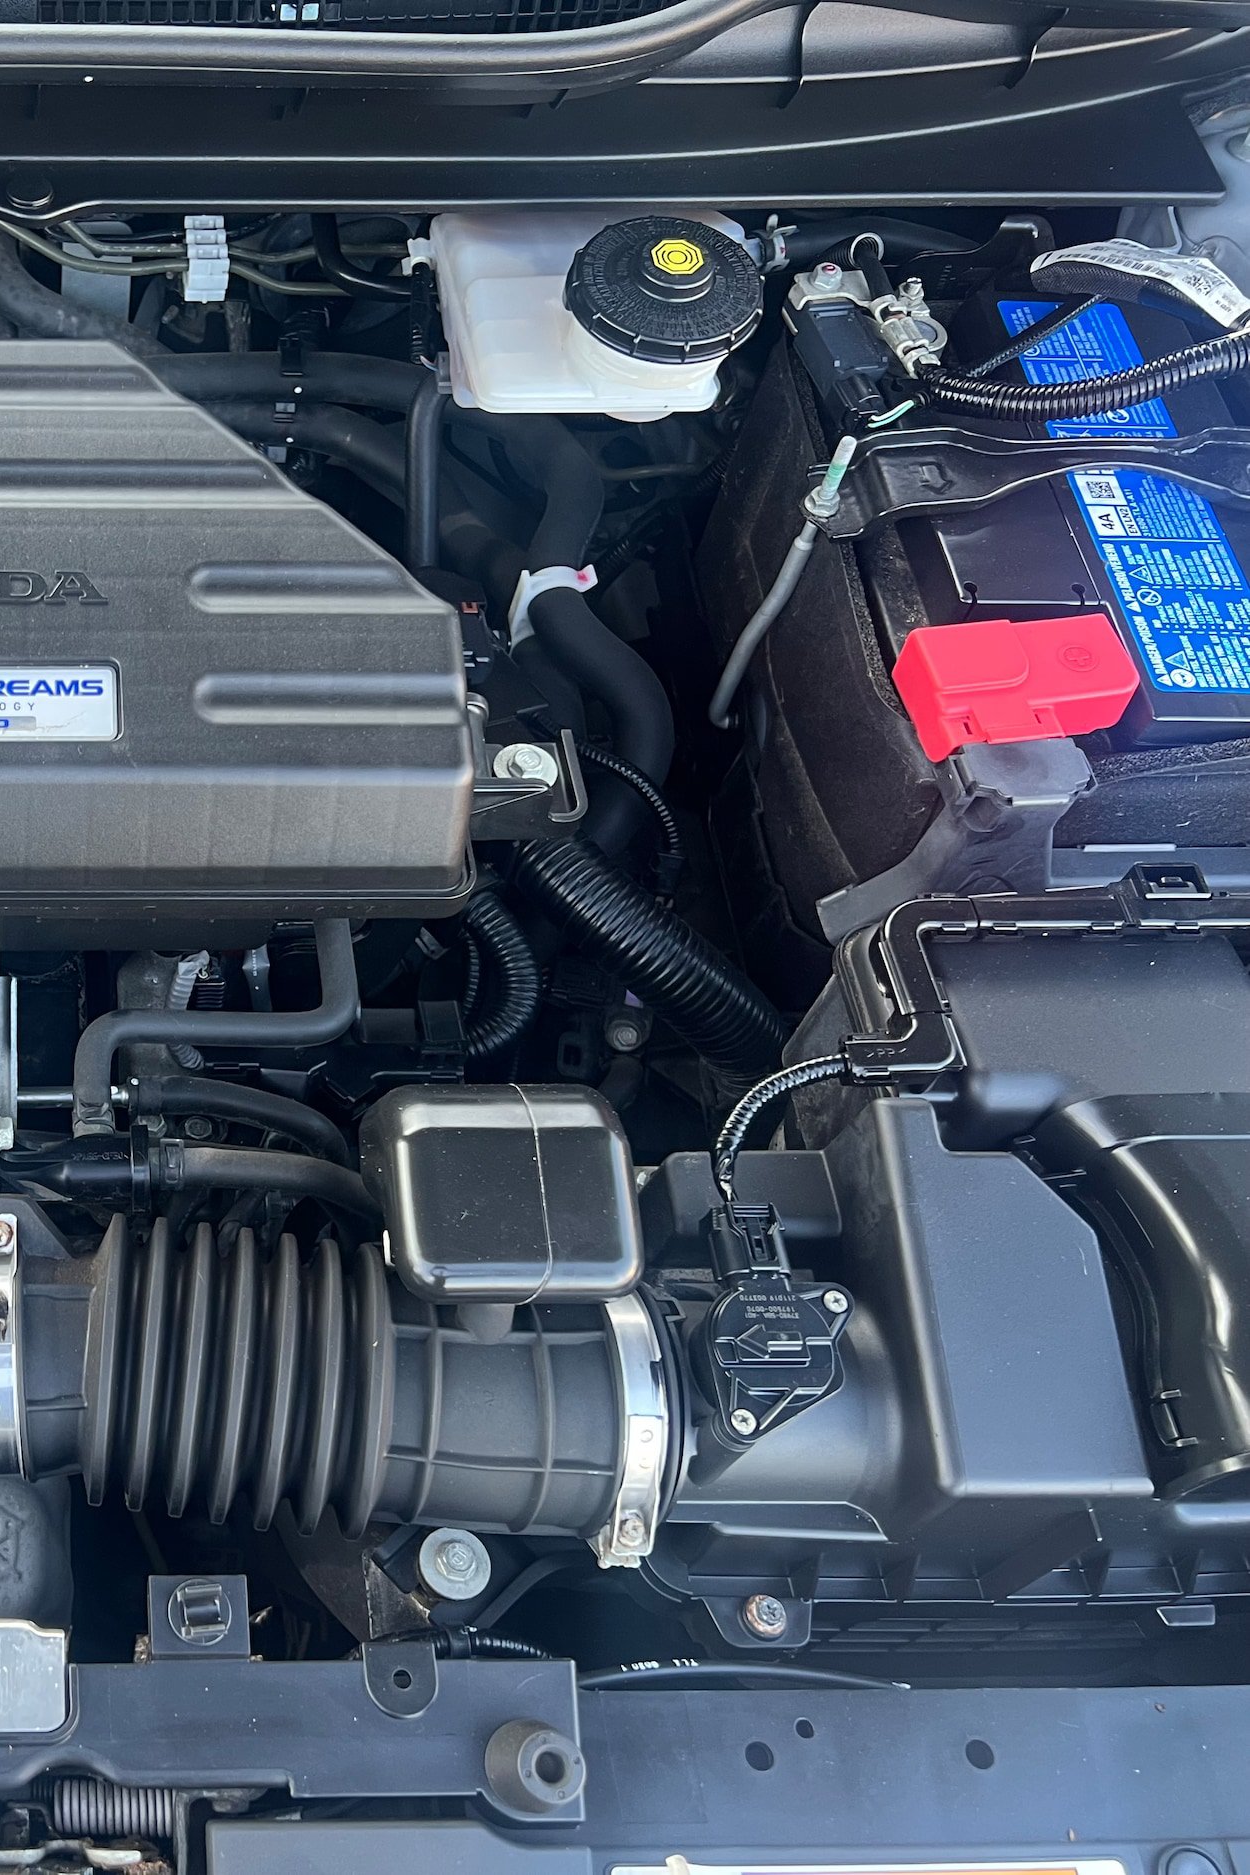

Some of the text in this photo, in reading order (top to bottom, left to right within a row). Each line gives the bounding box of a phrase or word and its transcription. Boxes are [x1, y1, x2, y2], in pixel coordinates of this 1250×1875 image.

[1096, 513, 1117, 529] 4A
[1118, 508, 1138, 533] EN LN2
[1100, 543, 1138, 600] PELIGRO/VENENO
[1131, 615, 1169, 674] DANGER/POISON
